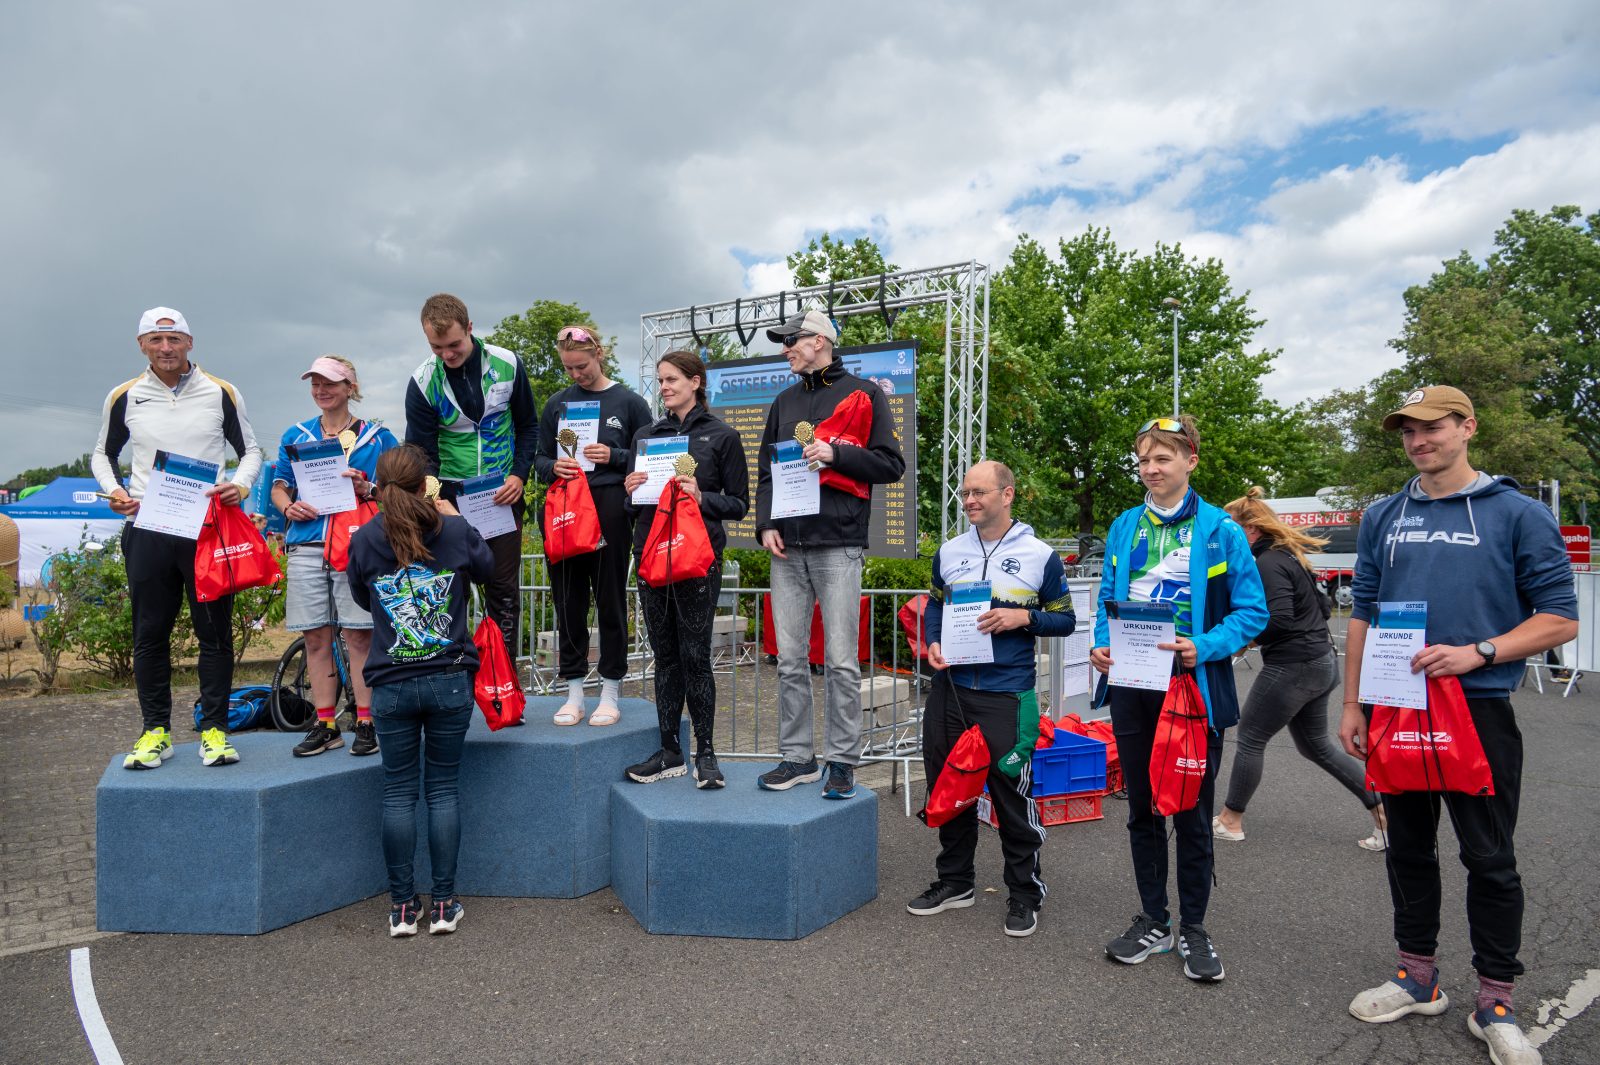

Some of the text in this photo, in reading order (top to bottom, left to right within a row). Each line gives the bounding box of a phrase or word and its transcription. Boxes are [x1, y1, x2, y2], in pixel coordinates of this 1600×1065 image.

[891, 368, 912, 376] OSTSEE
[720, 376, 768, 394] OSTSEE
[304, 459, 337, 469] URKUNDE
[165, 476, 203, 490] URKUNDE
[1278, 512, 1351, 525] ER-SERVICE
[1385, 530, 1481, 547] HEAD
[1561, 534, 1589, 544] sgabe
[213, 542, 251, 558] BENZ
[953, 604, 982, 613] URKUNDE
[1123, 623, 1163, 631] URKUNDE
[1378, 632, 1414, 640] URKUNDE
